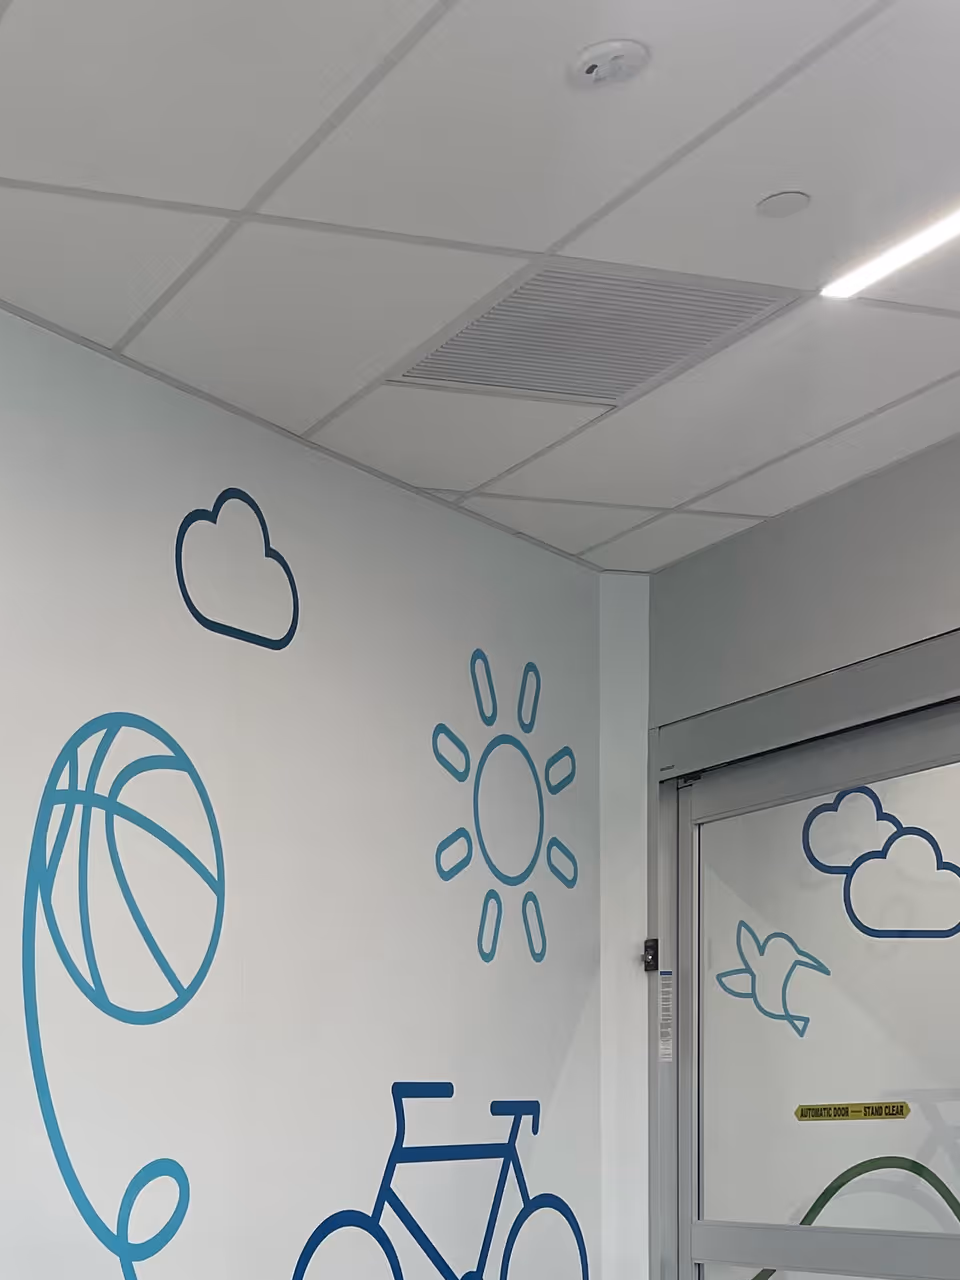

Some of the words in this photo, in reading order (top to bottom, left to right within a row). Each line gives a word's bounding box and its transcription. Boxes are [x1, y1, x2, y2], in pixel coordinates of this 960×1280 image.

[800, 1107, 832, 1119] AUTOMATIC
[833, 1106, 849, 1118] DOOR
[863, 1105, 883, 1117] STAND
[884, 1104, 904, 1116] CLEAR
